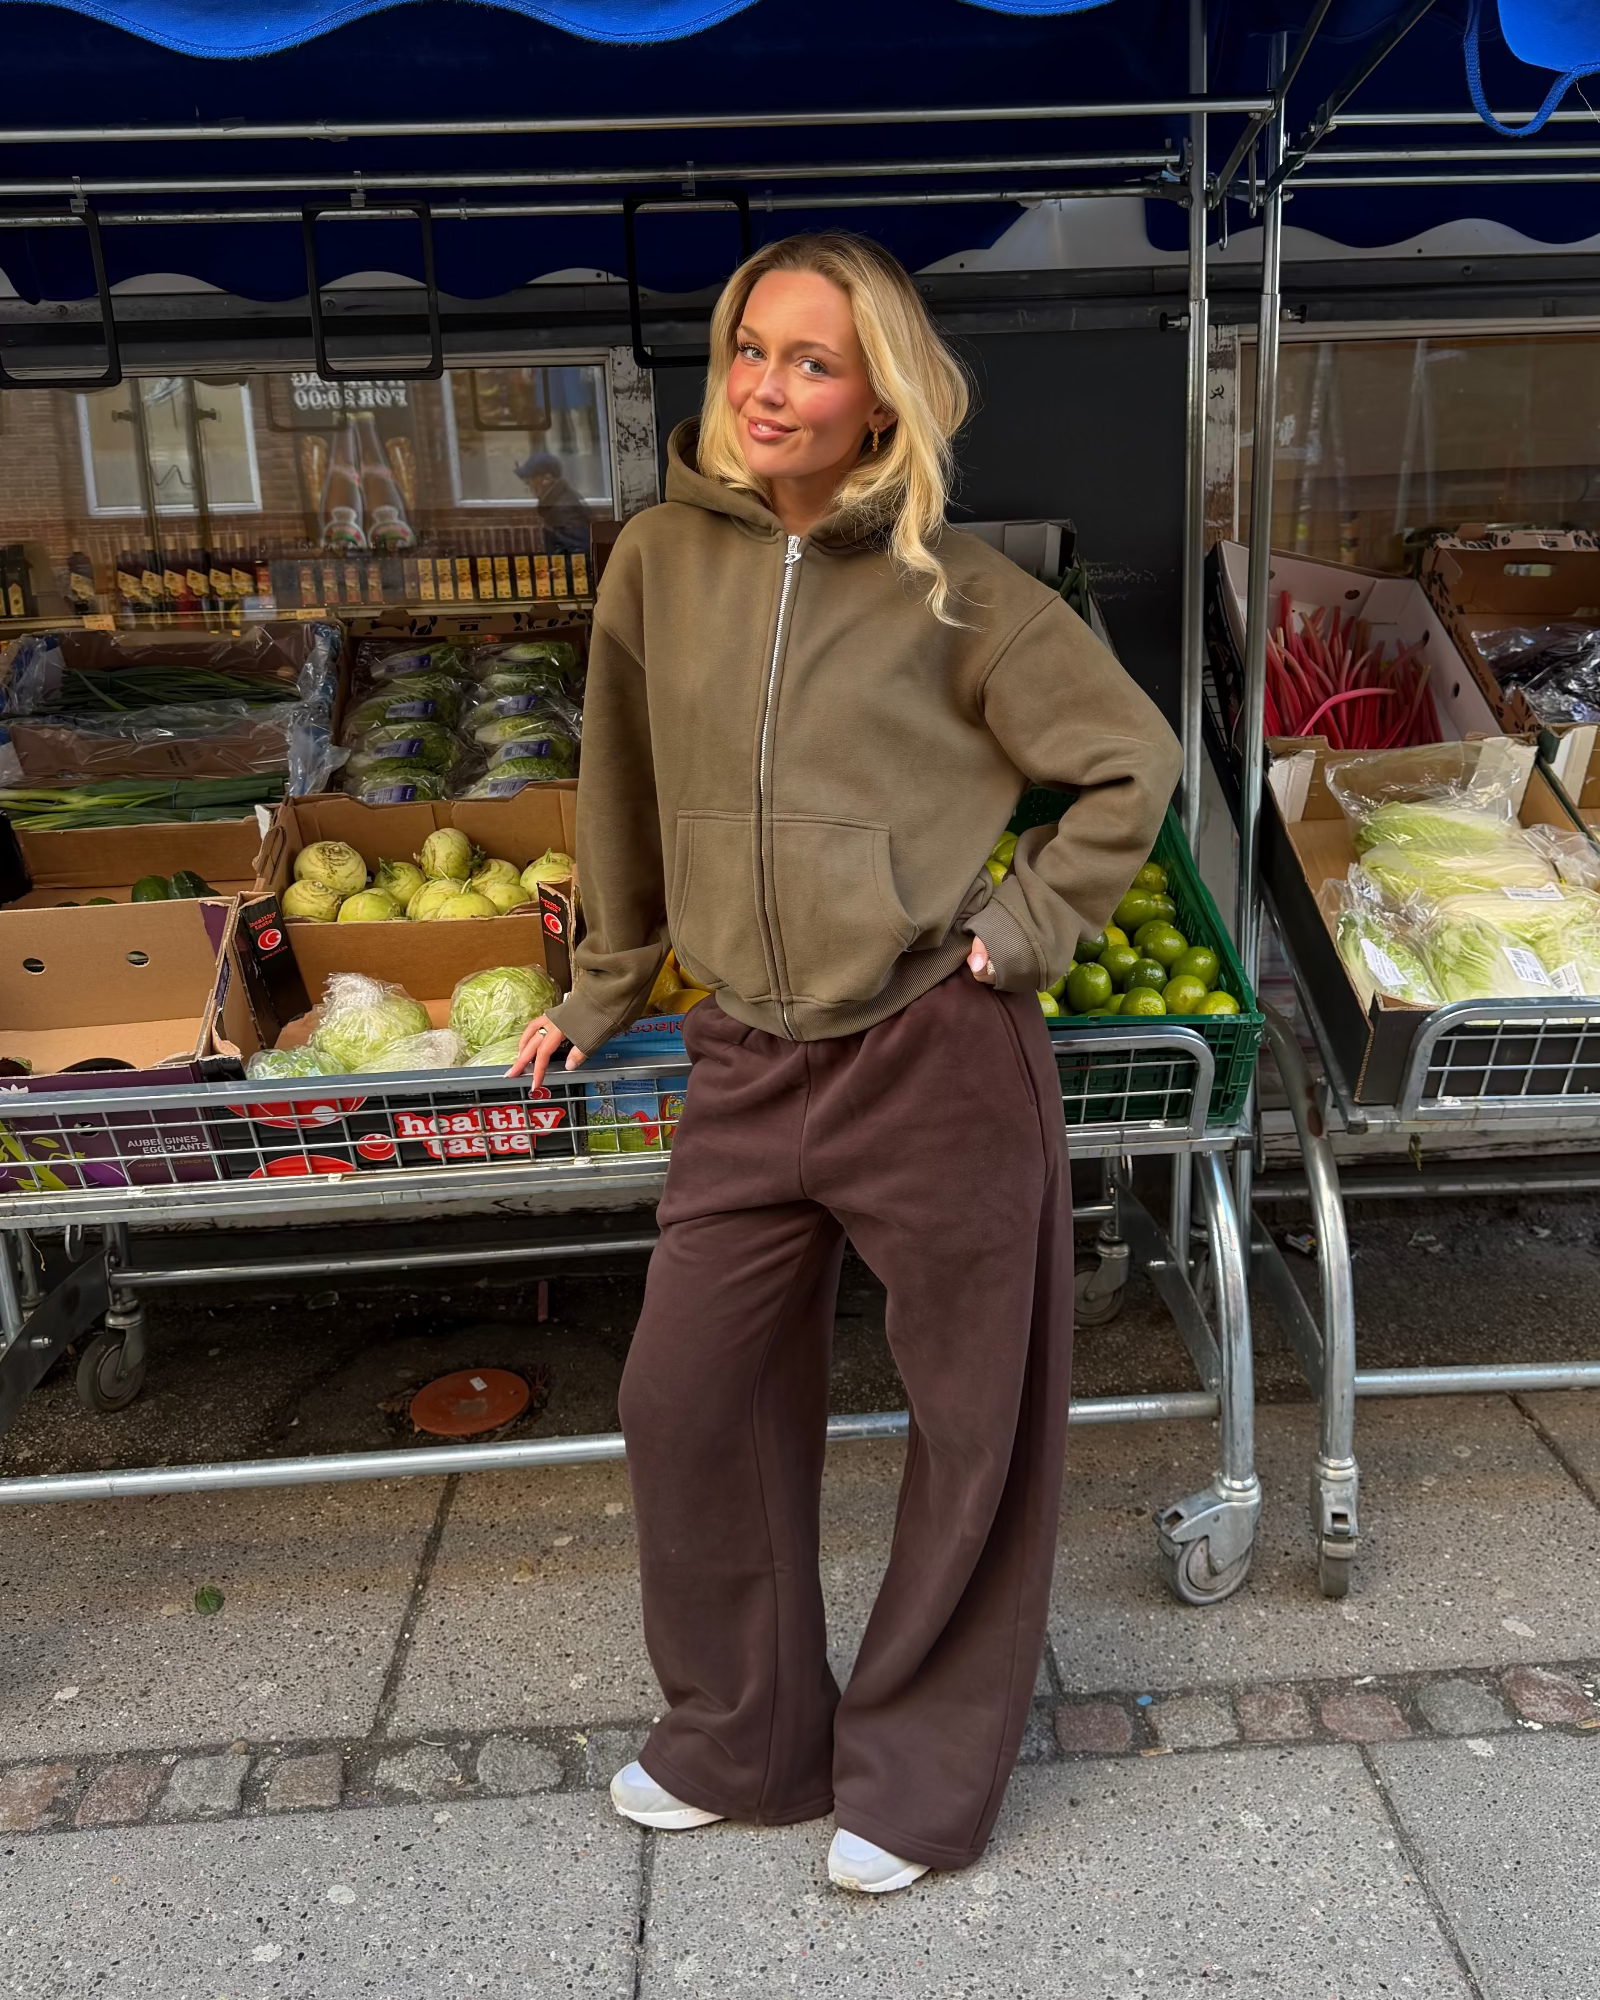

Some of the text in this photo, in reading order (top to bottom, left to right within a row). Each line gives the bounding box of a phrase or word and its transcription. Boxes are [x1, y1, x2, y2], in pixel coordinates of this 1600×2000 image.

[398, 1108, 560, 1136] healthy
[127, 1135, 199, 1148] AUBEGINES
[428, 1134, 531, 1156] taste
